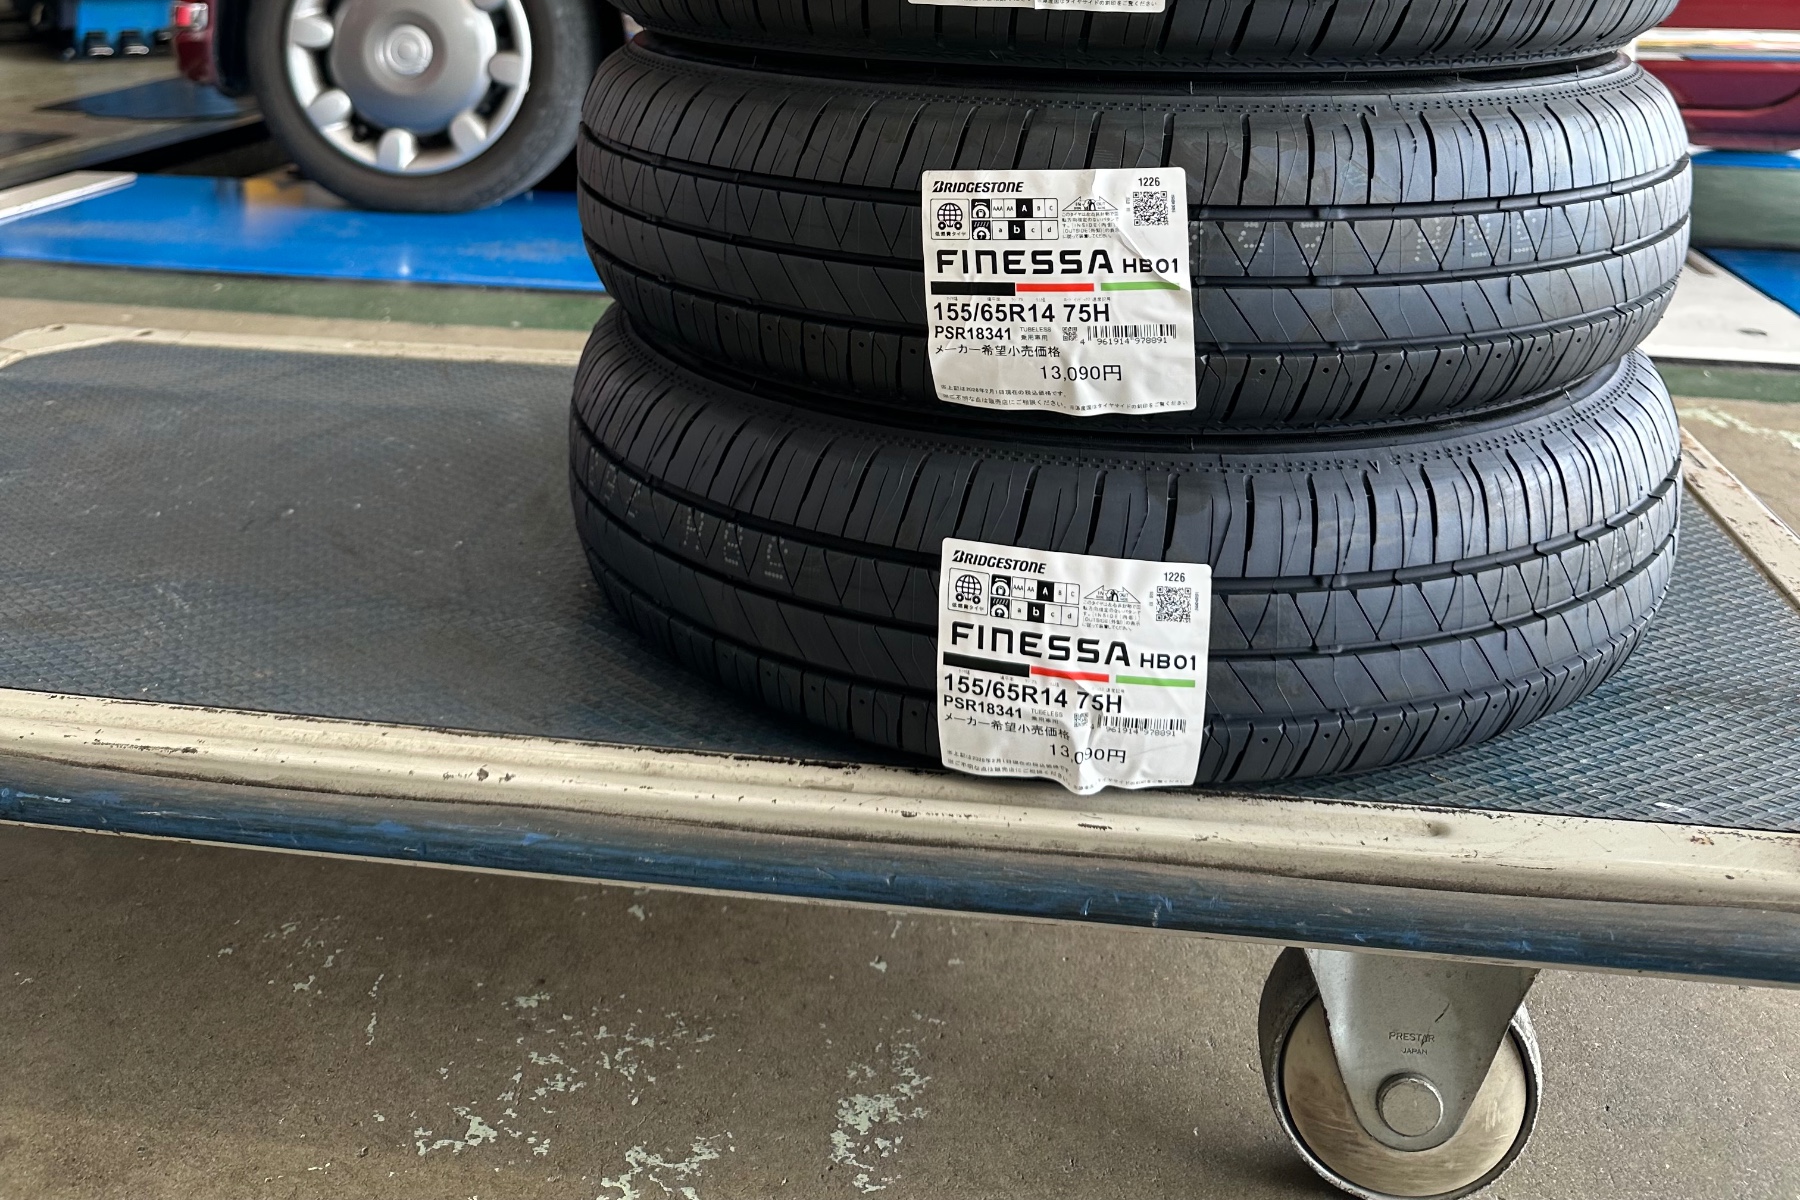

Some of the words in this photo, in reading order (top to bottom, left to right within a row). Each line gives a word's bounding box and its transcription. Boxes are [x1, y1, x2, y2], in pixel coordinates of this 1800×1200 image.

[932, 180, 1024, 193] BRIDGESTONE
[1138, 176, 1160, 187] 1226
[1021, 204, 1028, 212] A
[936, 249, 1114, 274] FINESSA
[933, 302, 1055, 322] 155/65R14
[1063, 303, 1110, 322] 75H
[934, 325, 1011, 340] PSR18341
[1096, 337, 1130, 345] 961914
[935, 344, 1061, 357] メーカー希望小売価格
[1040, 365, 1122, 381] 13,090円
[952, 549, 1046, 574] BRIDGESTONE
[1164, 572, 1186, 582] 1226
[1042, 586, 1049, 596] A
[951, 621, 1130, 666] FINESSA
[944, 673, 1068, 708] 155/65R14
[1077, 691, 1122, 713] 75H
[943, 694, 1022, 718] PSR18341
[944, 712, 1070, 740] メーカー希望小売価格
[1105, 726, 1139, 735] 961914
[1049, 743, 1126, 765] 13,090円
